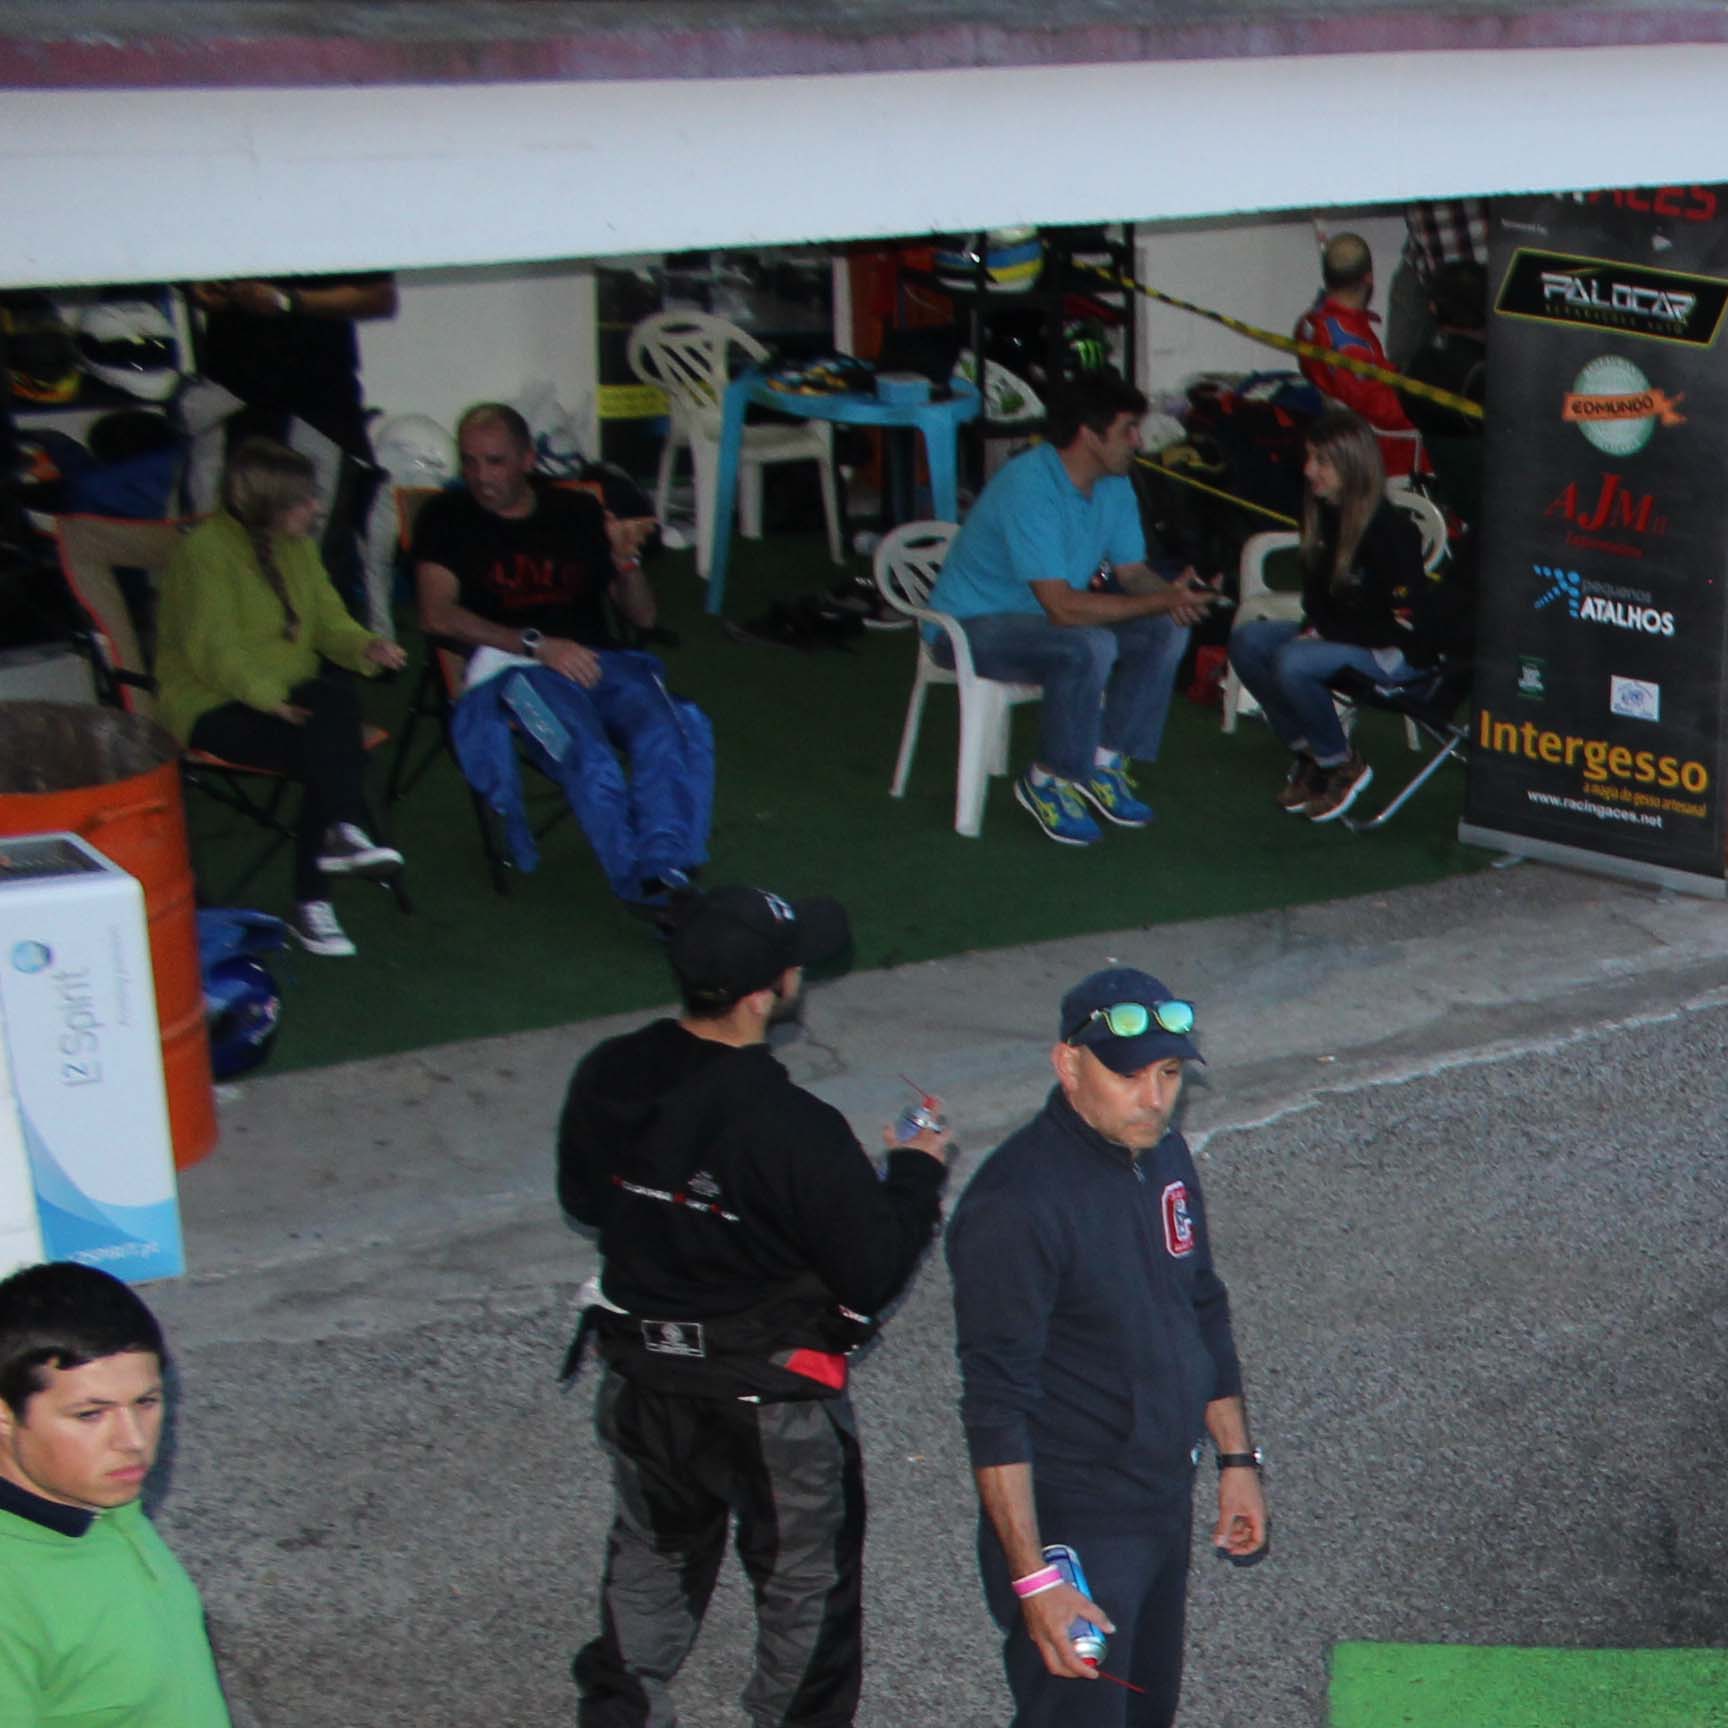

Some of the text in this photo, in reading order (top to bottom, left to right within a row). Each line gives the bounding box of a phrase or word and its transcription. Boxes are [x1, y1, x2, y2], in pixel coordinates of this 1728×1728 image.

[1571, 395, 1654, 415] EDMUNDO
[1580, 596, 1676, 638] ATALHOS
[1480, 708, 1709, 794] Intergesso
[1527, 788, 1663, 830] www.racingaces.net
